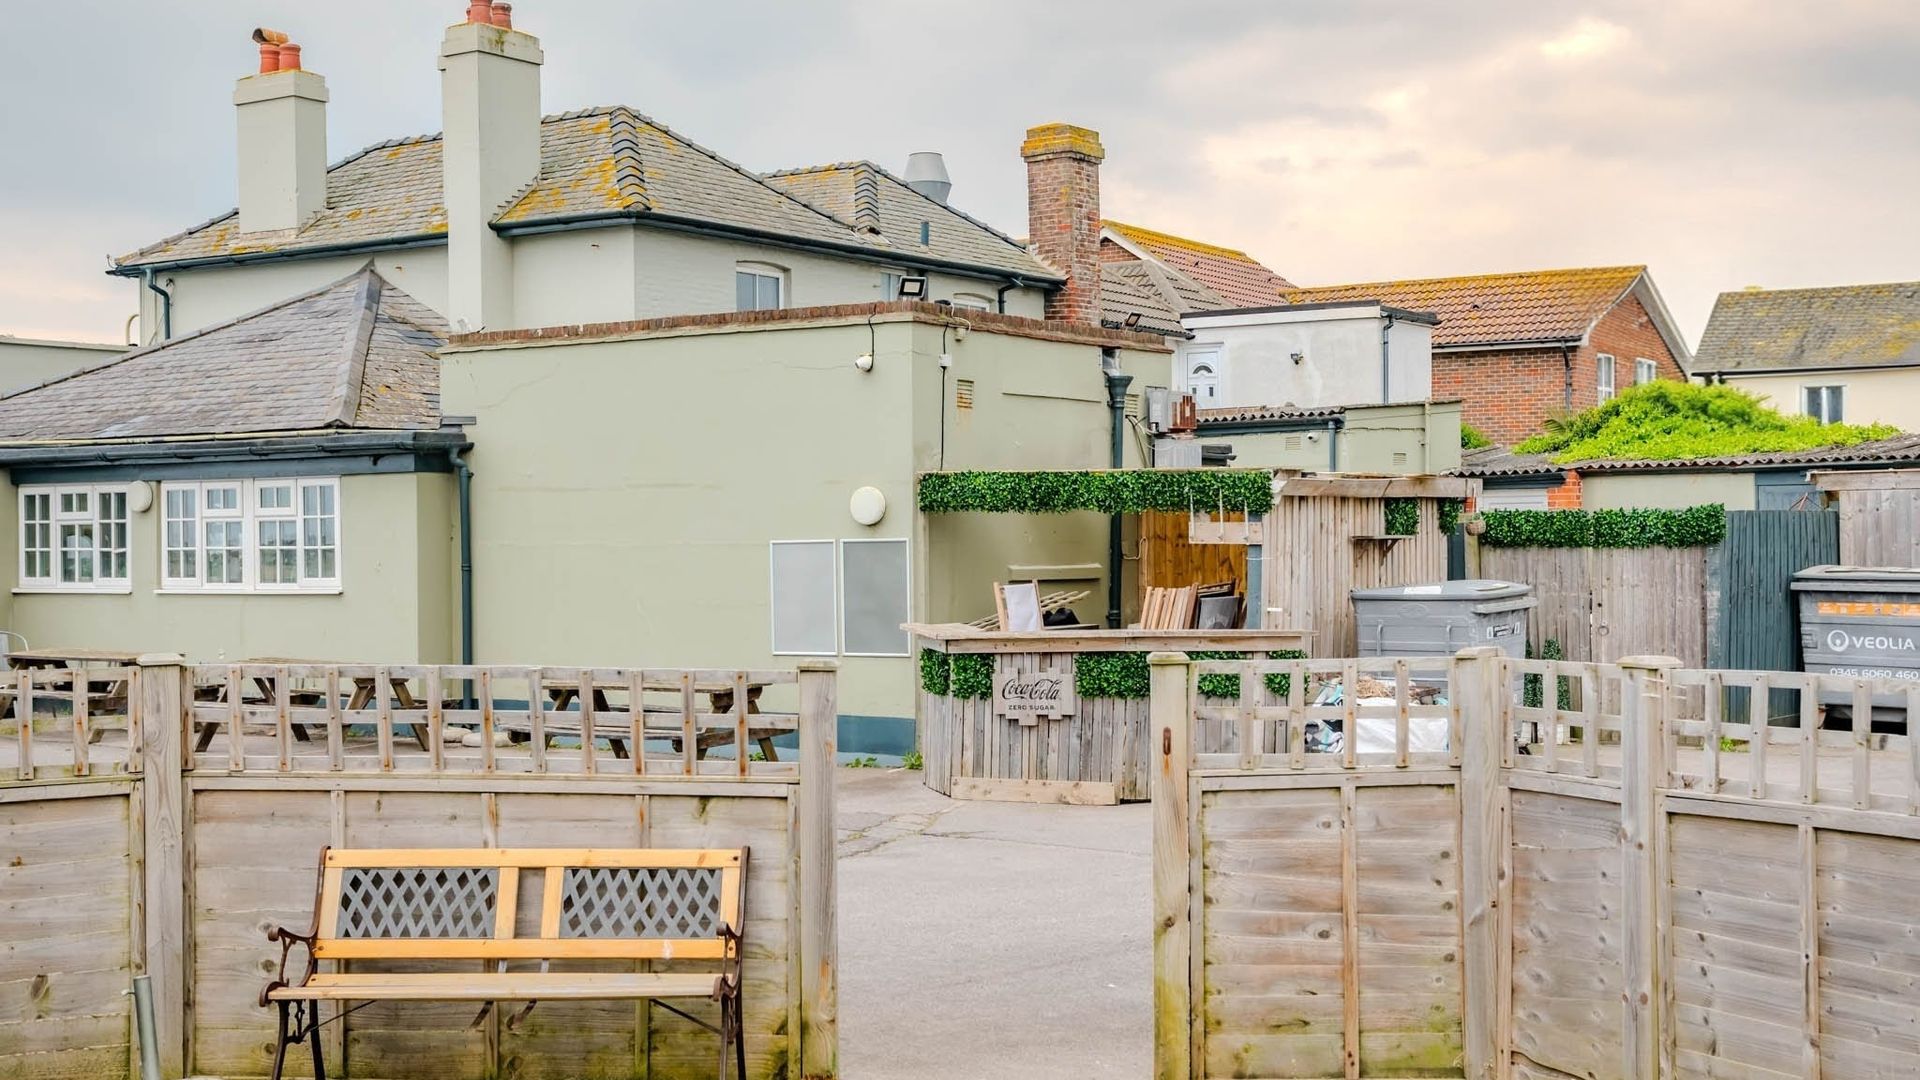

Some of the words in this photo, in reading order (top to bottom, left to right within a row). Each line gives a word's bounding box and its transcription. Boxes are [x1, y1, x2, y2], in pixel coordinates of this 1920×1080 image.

[1851, 636, 1916, 651] VEOLIA
[1830, 667, 1858, 678] 0345
[1862, 669, 1892, 679] 6060
[1895, 670, 1919, 680] 460
